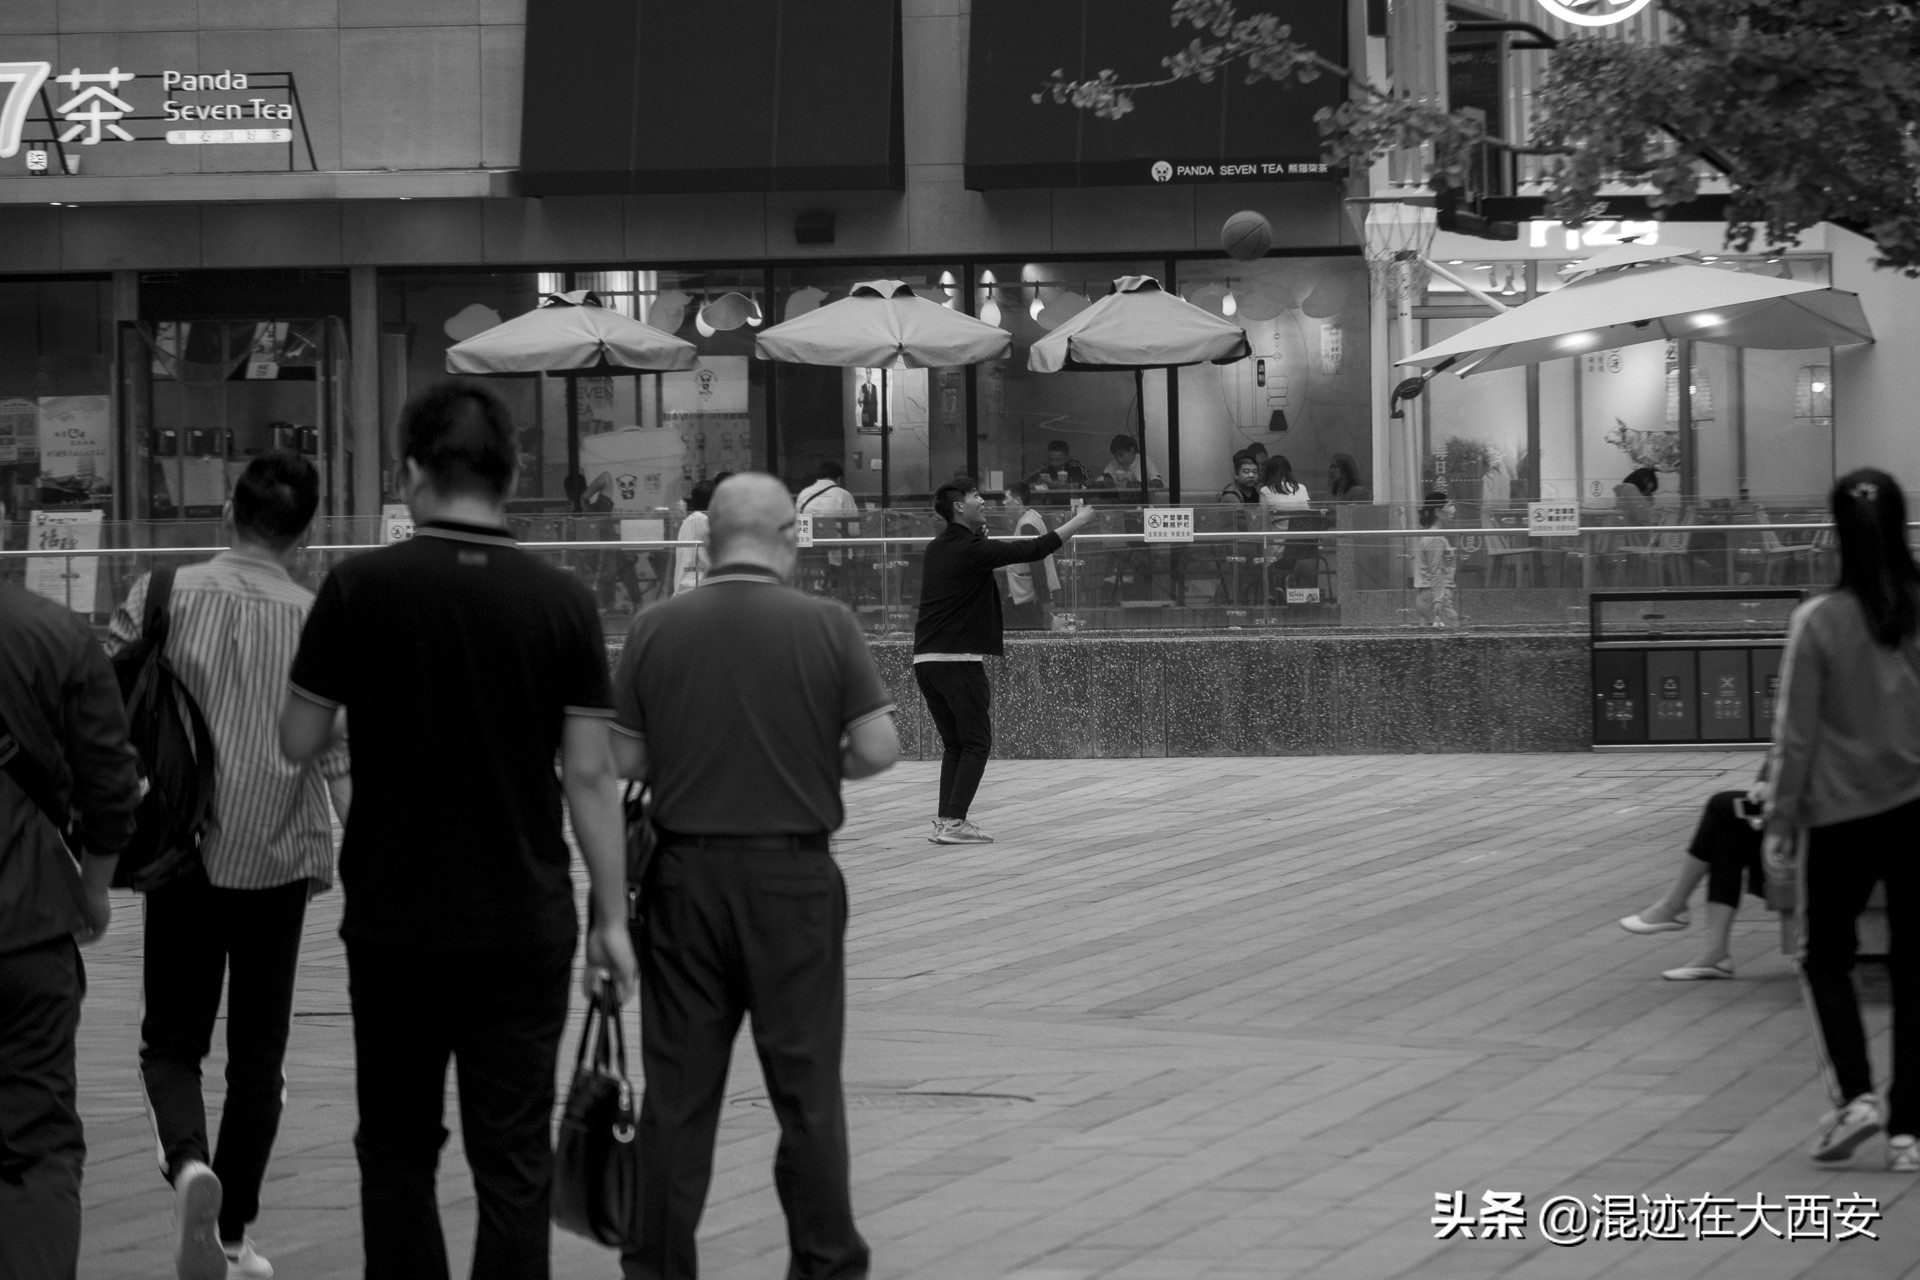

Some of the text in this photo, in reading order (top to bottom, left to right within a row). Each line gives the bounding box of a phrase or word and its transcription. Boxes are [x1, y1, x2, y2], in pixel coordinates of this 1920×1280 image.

[163, 70, 248, 91] Panda
[163, 98, 292, 121] Seven Tea
[1177, 164, 1283, 176] PANDA SEVEN TEA
